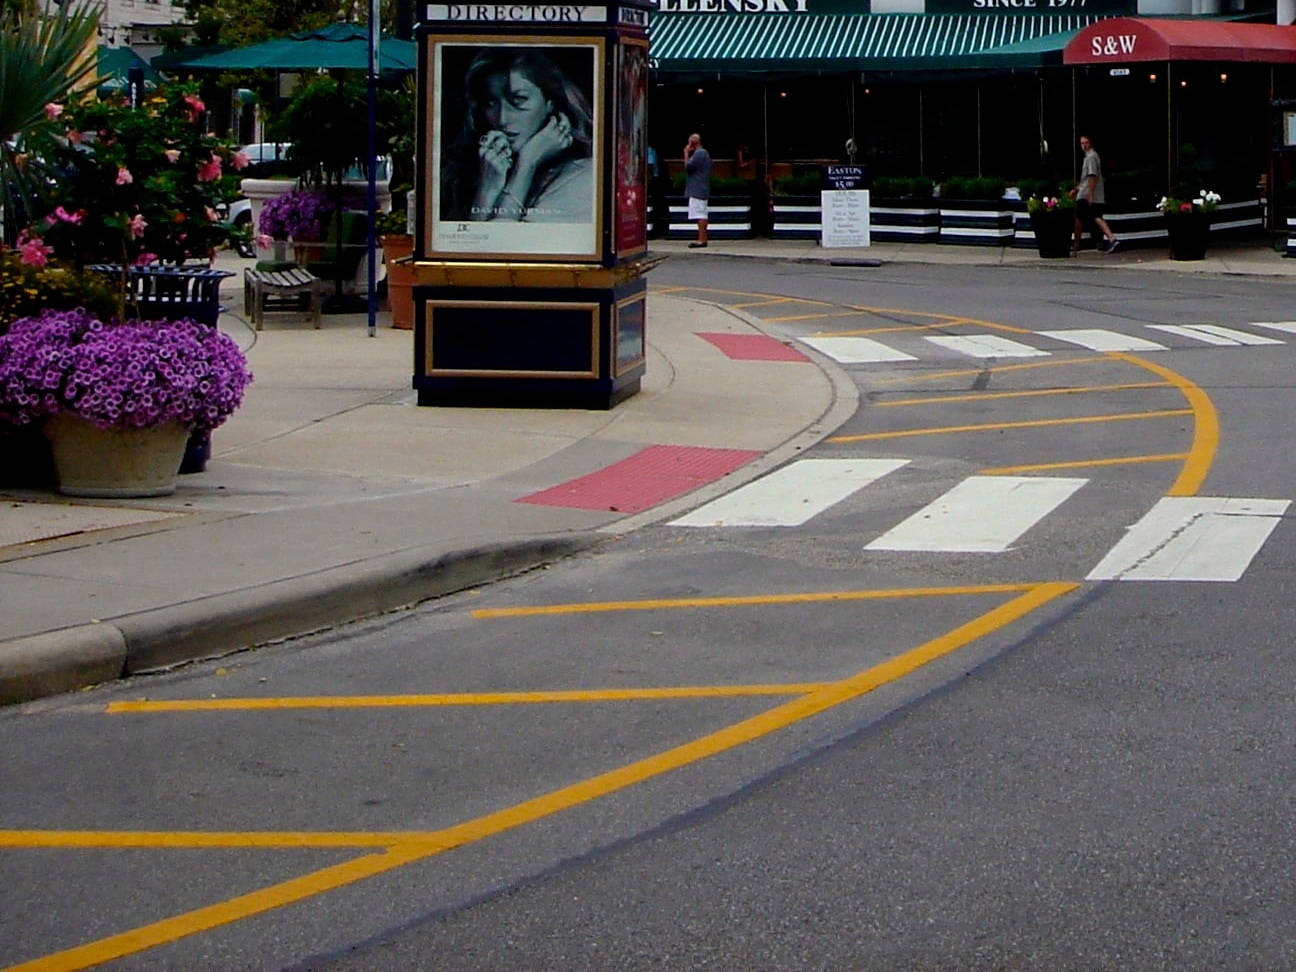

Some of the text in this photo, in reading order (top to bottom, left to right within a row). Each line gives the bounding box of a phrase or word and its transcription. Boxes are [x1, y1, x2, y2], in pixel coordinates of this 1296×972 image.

[446, 4, 587, 21] DIRECTORY
[1091, 34, 1137, 57] S&W
[471, 207, 508, 215] DAVID
